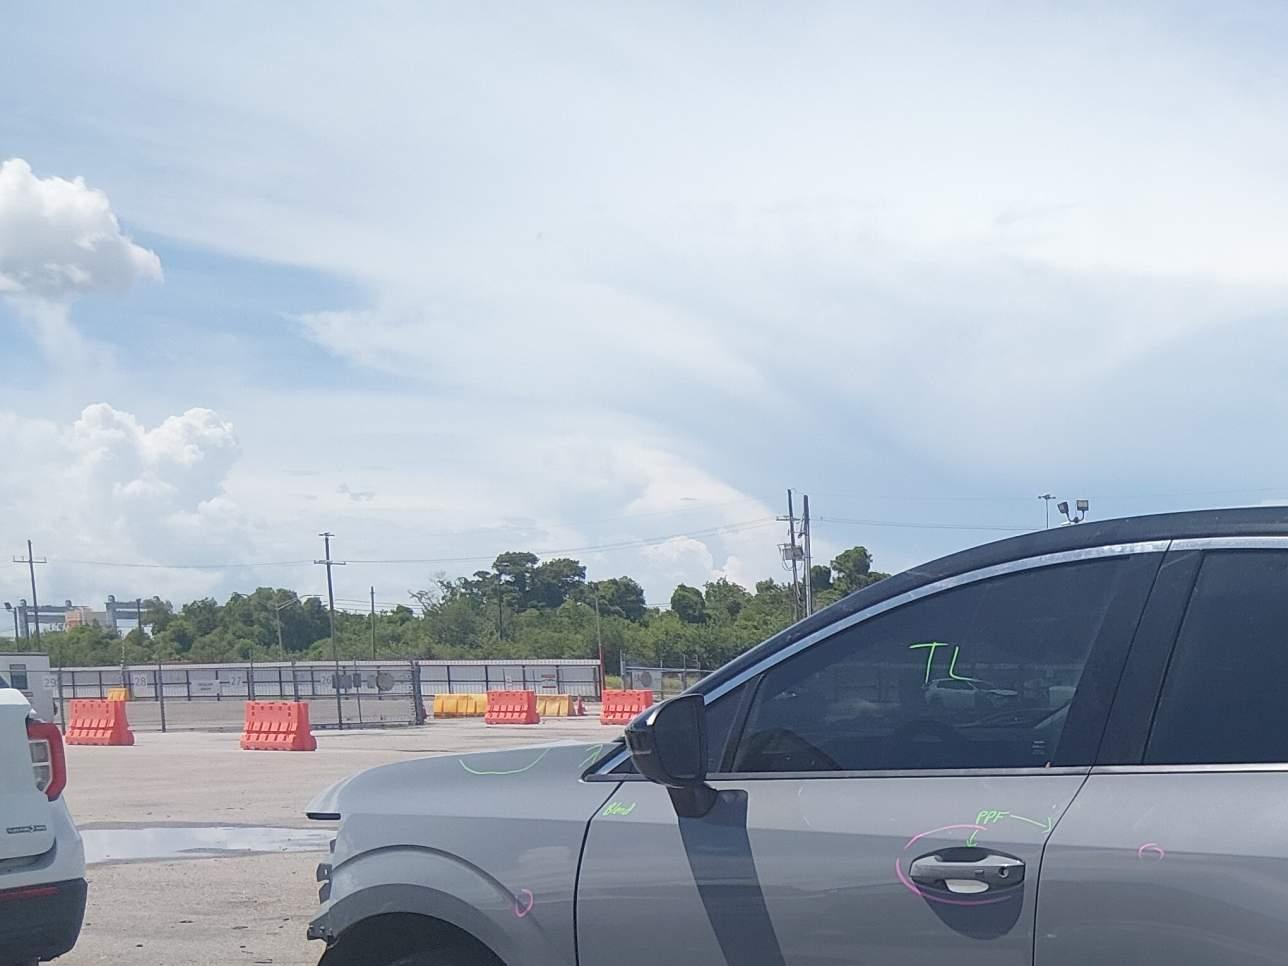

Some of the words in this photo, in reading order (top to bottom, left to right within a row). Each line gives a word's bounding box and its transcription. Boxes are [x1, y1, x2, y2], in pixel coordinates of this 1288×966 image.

[908, 641, 978, 685] TL
[43, 678, 57, 688] 29
[134, 677, 147, 687] 28
[230, 676, 242, 686] 27
